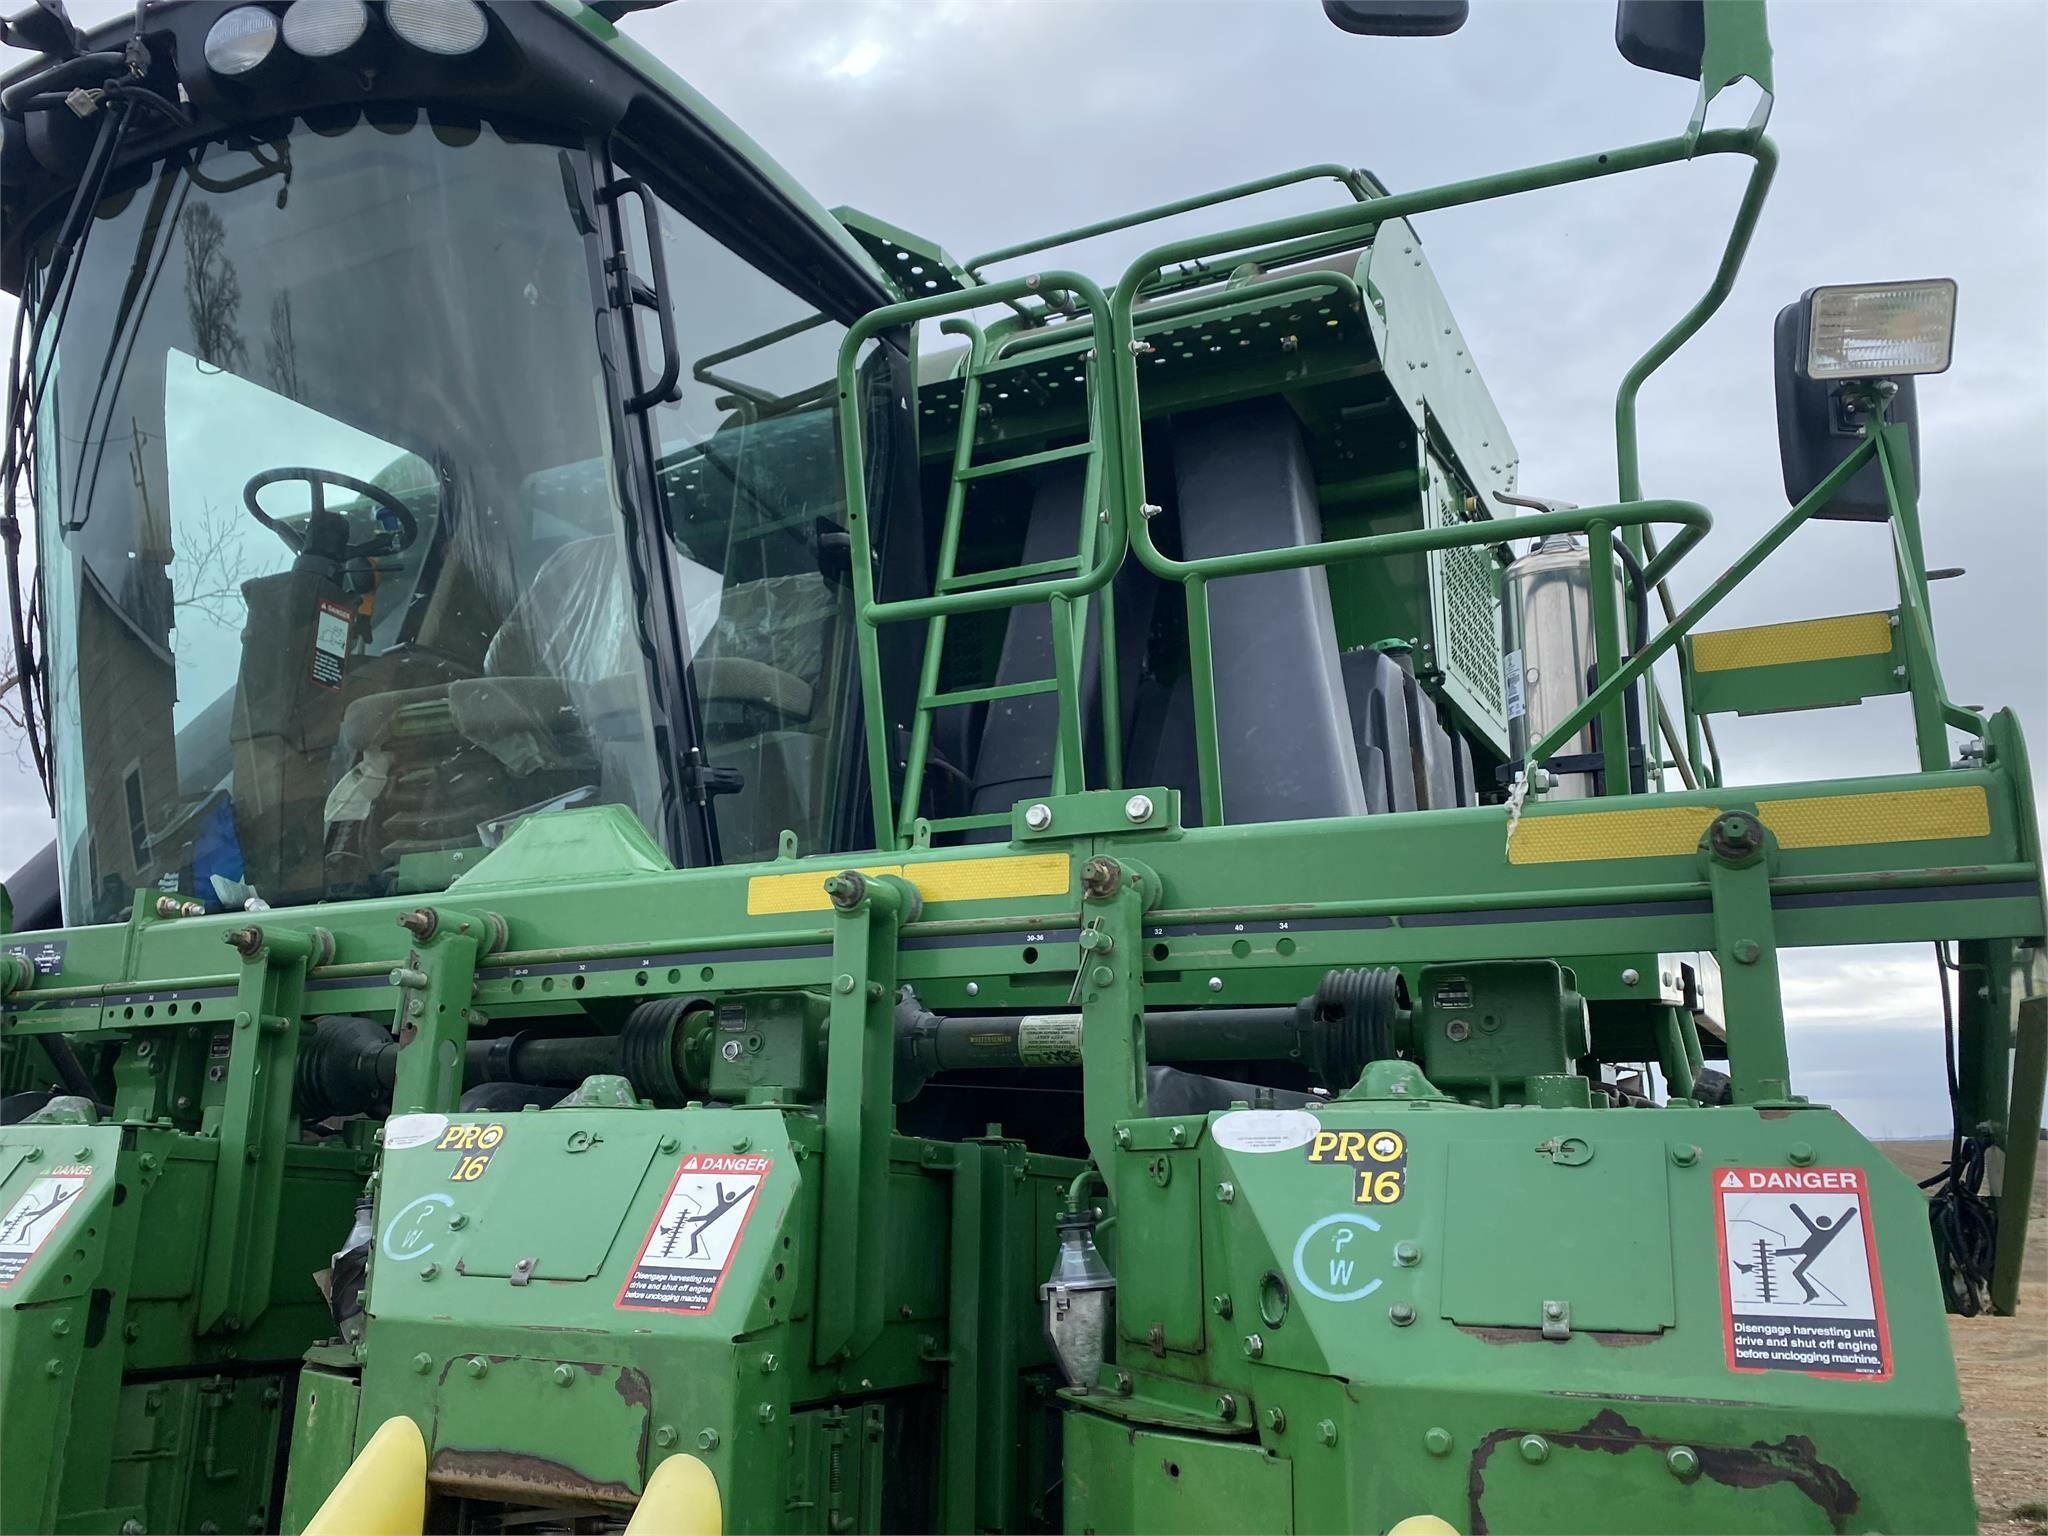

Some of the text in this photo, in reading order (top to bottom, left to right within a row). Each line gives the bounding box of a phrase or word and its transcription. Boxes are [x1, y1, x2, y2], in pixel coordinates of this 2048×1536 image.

[1279, 922, 1288, 930] 34
[437, 1124, 504, 1150] PRO
[1308, 1131, 1403, 1163] PRO
[451, 1155, 490, 1182] 16
[701, 1157, 769, 1171] DANGER
[1356, 1171, 1400, 1203] 16
[1749, 1172, 1857, 1188] DANGER
[633, 1271, 717, 1284] Disengage harvesting unit
[1329, 1260, 1354, 1285] W
[629, 1281, 647, 1289] drive
[661, 1283, 677, 1291] shut
[678, 1284, 689, 1292] off
[689, 1285, 713, 1294] engine
[625, 1291, 645, 1299] before
[645, 1292, 680, 1302] unclogging
[1734, 1322, 1876, 1339] Disengage harvesting unit
[1735, 1335, 1878, 1352] drive and shut off engine
[1736, 1349, 1881, 1364] before unclogging machine.
